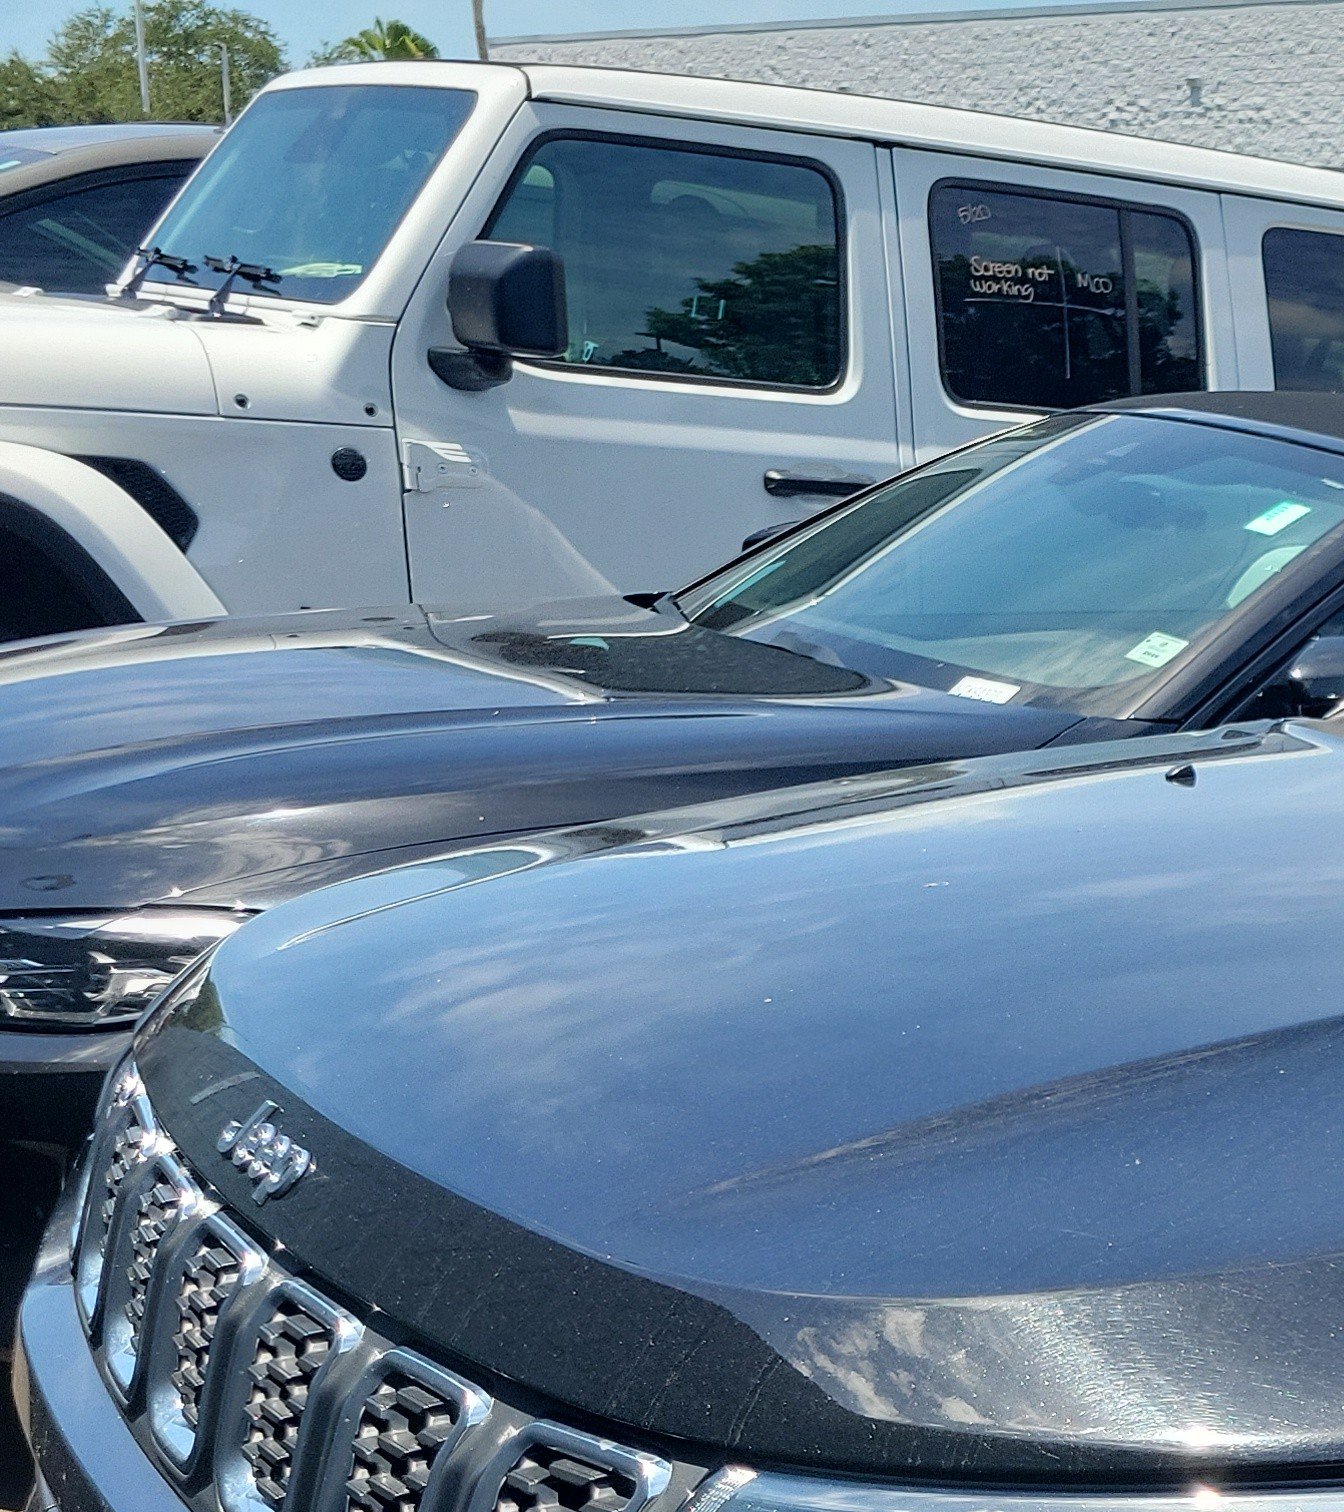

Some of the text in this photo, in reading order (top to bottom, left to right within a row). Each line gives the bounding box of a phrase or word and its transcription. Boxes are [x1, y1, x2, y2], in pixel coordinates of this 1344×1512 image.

[969, 255, 1055, 281] Screen not
[217, 1100, 312, 1206] Jeep
